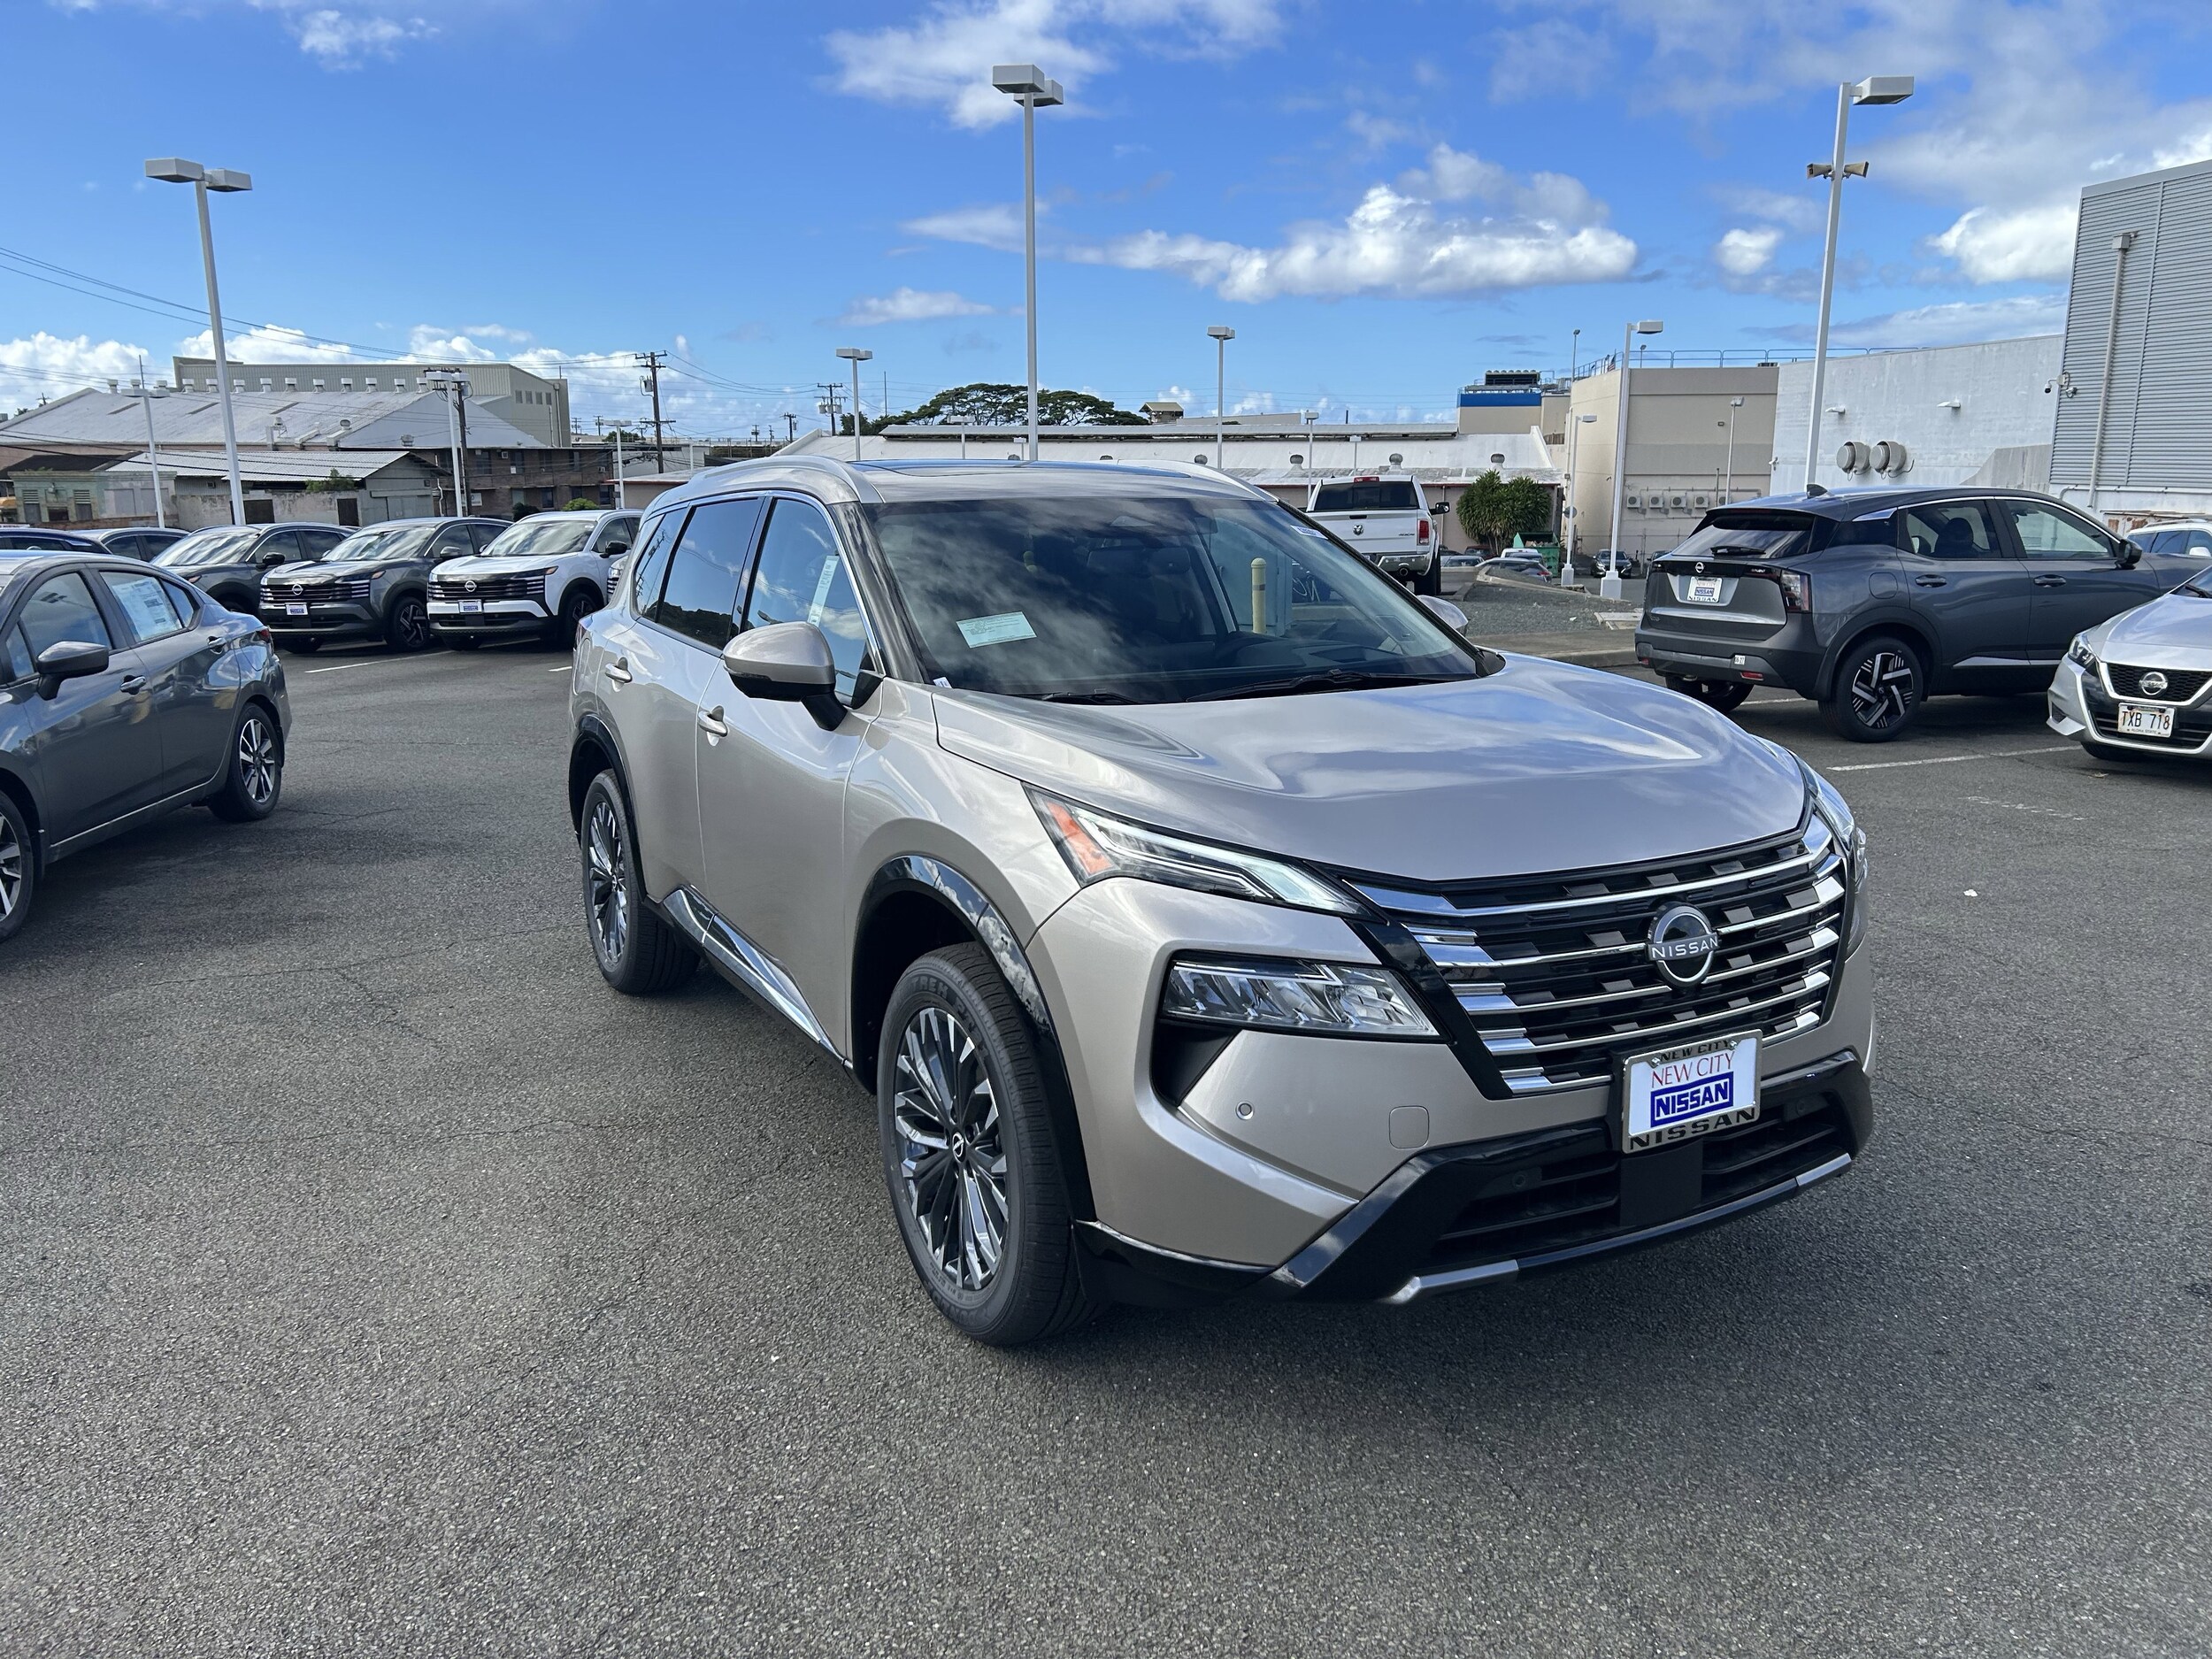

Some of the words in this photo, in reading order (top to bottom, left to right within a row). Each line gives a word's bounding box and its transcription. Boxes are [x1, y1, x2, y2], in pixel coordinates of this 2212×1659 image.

[2122, 711, 2142, 727] TXB
[2150, 714, 2170, 730] 718
[1652, 936, 1718, 958] NISSAN
[1660, 1047, 1693, 1062] NEW
[1697, 1039, 1731, 1054] CITY
[1651, 1062, 1694, 1088] NEW
[1696, 1051, 1735, 1077] CITY
[1655, 1080, 1728, 1118] NISSAN
[1630, 1107, 1755, 1150] NISSAN
